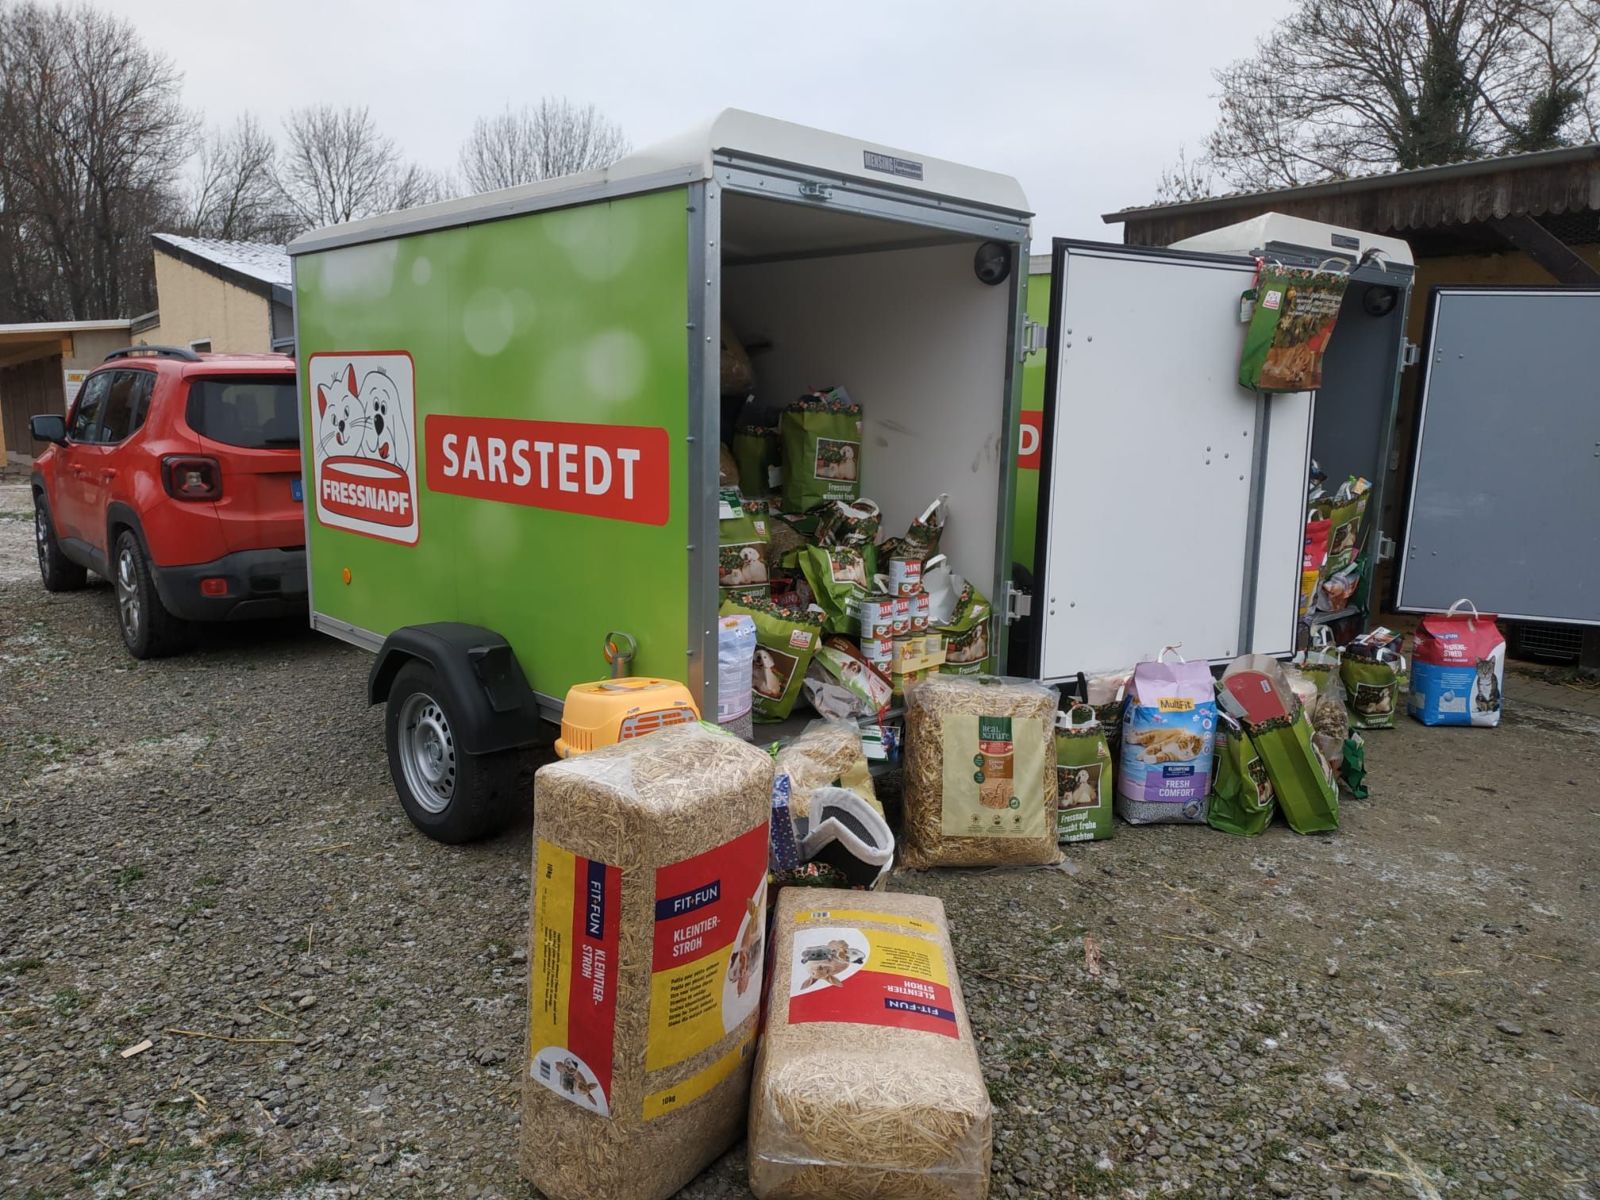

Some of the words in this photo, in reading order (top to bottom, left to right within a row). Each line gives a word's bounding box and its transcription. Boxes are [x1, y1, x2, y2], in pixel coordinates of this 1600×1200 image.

[1018, 424, 1040, 456] D
[442, 433, 640, 499] SARSTEDT
[322, 480, 409, 515] FRESSNAPF
[1159, 788, 1195, 797] COMFORT
[1165, 780, 1190, 788] FRESH
[674, 916, 720, 943] KLEINTIER-
[672, 937, 703, 957] STROH
[581, 944, 593, 979] STROH
[903, 980, 935, 993] STROH
